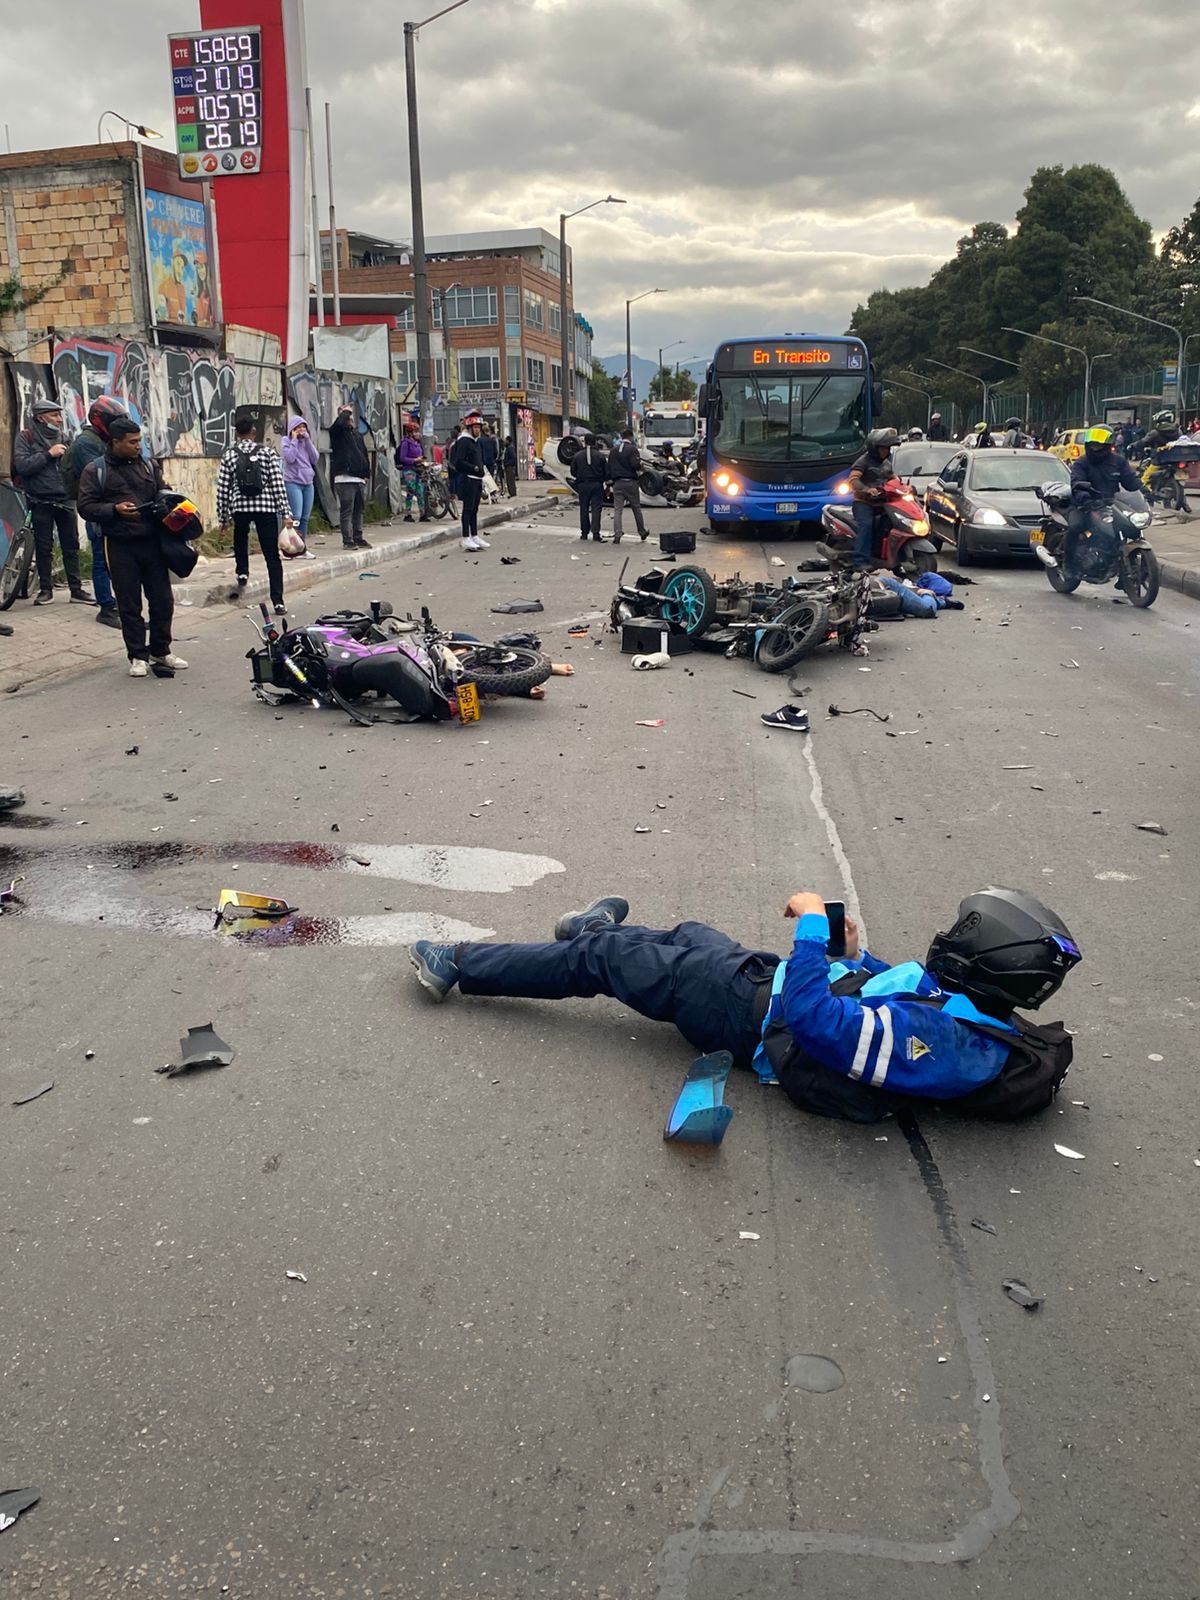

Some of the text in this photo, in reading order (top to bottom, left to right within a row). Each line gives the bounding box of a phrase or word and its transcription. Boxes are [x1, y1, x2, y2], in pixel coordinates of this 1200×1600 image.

[173, 48, 189, 58] CTE
[177, 106, 195, 115] ACPM
[181, 134, 194, 144] GNV
[753, 348, 831, 364] En Transito
